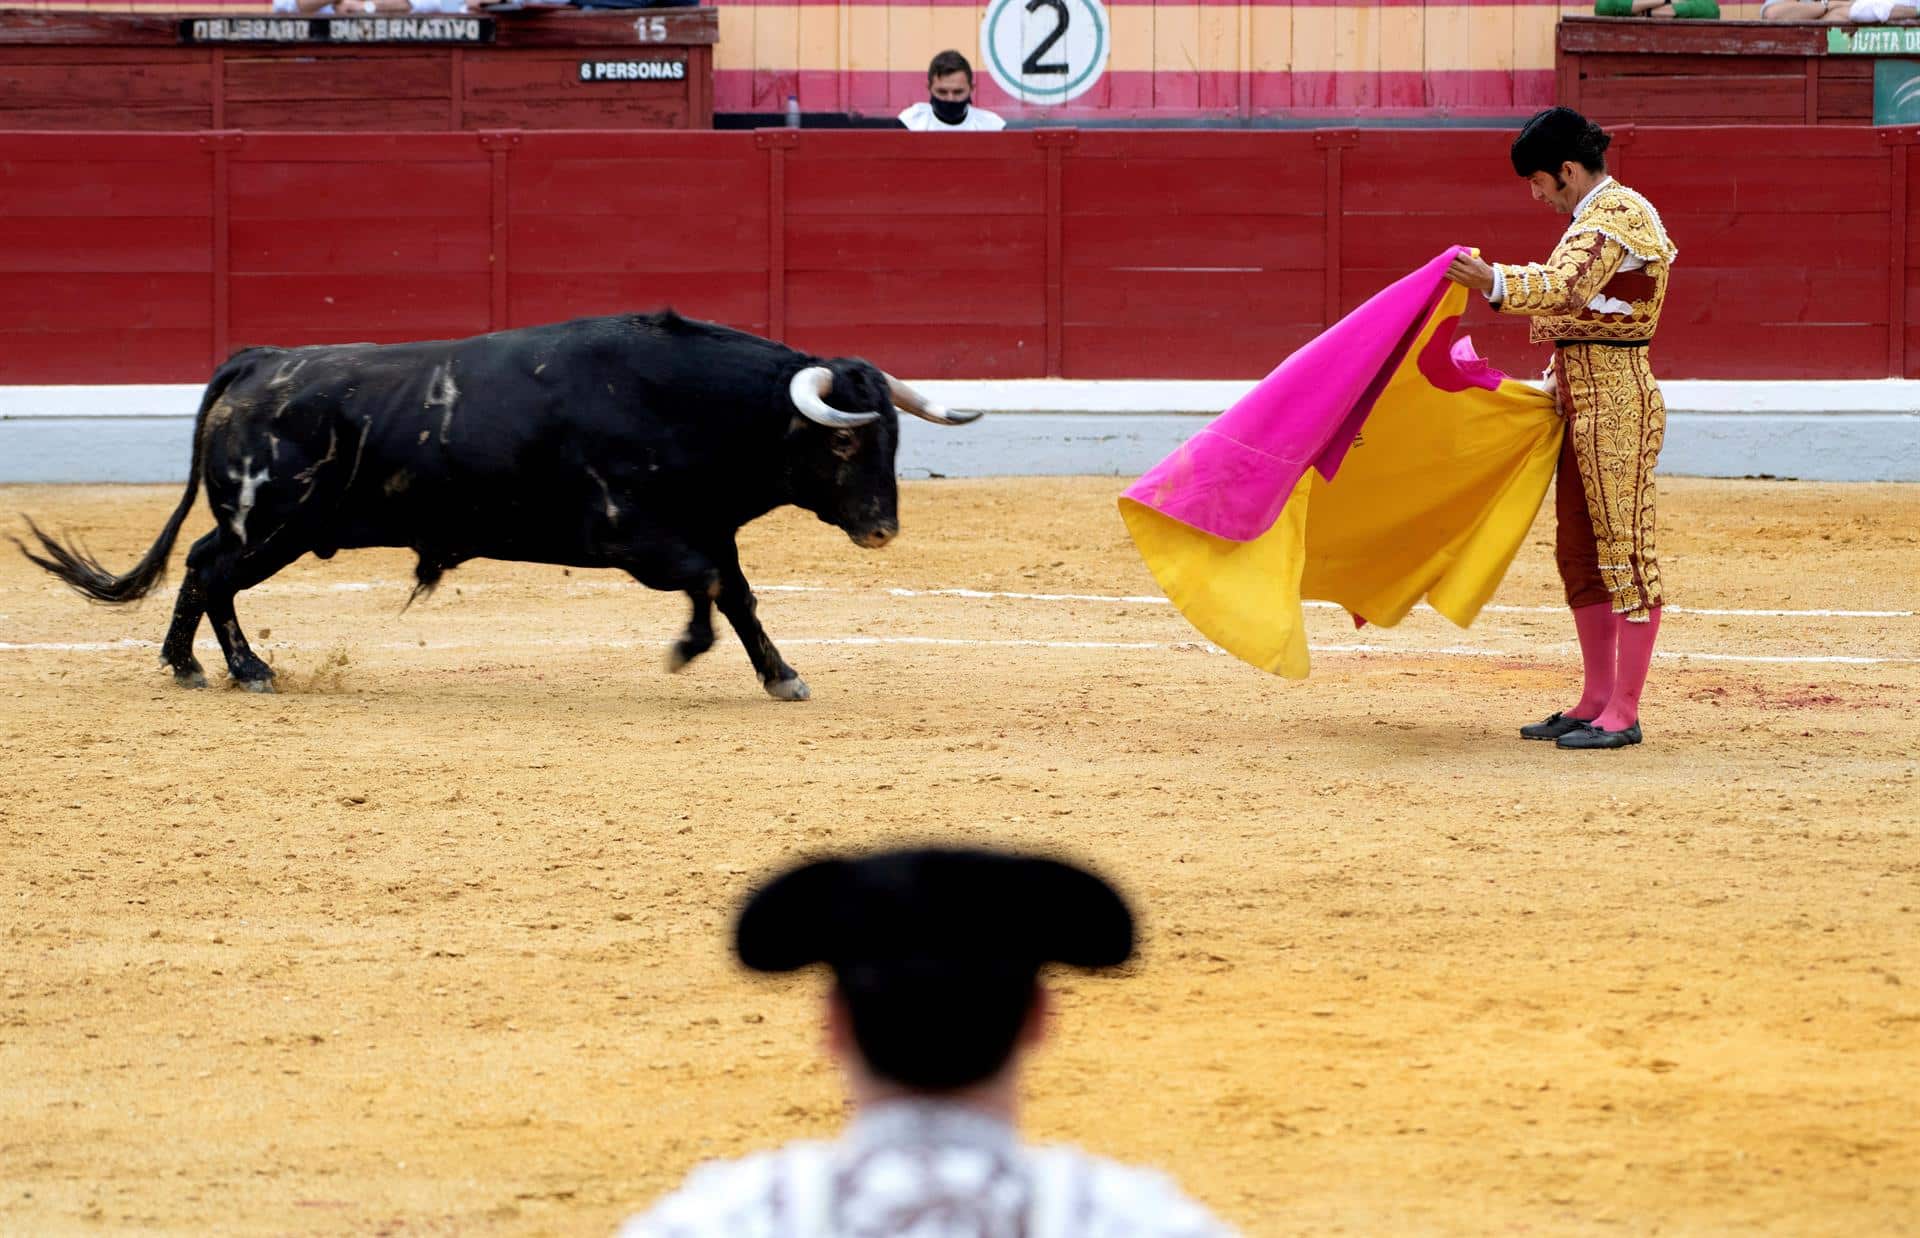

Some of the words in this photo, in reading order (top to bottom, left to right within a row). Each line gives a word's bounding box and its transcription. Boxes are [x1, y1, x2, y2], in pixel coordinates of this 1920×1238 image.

[633, 16, 668, 42] 15
[1022, 0, 1070, 74] 2
[1852, 31, 1900, 52] JUNTA
[580, 63, 591, 79] 6
[595, 62, 684, 79] PERSONAS
